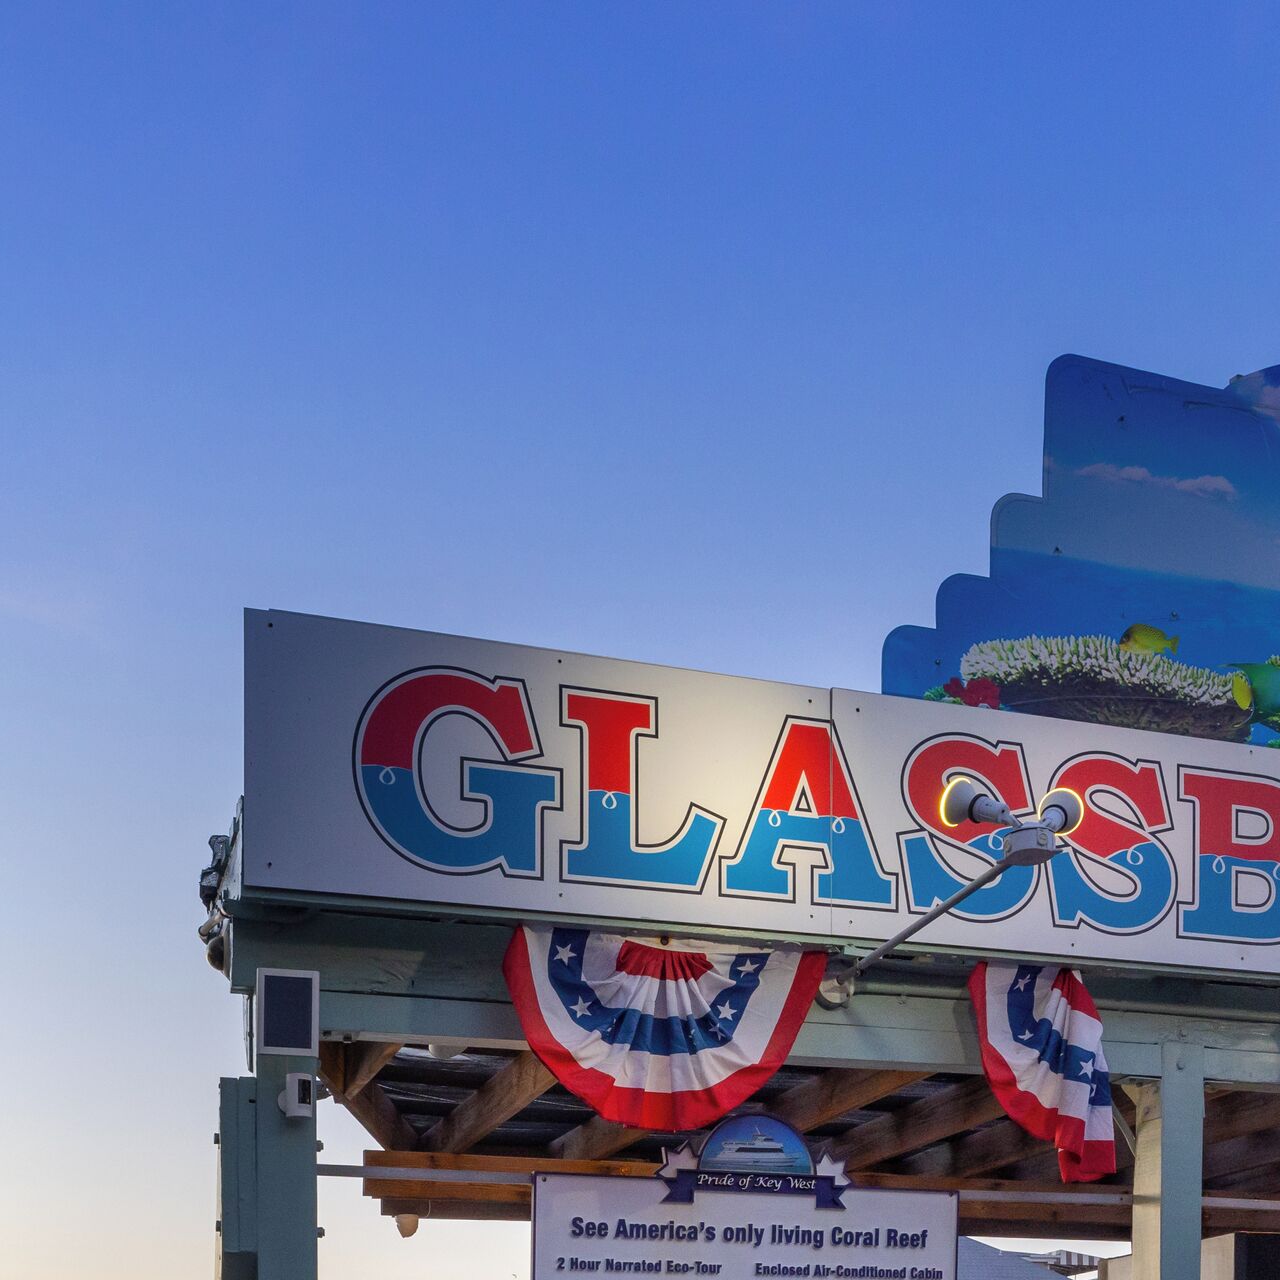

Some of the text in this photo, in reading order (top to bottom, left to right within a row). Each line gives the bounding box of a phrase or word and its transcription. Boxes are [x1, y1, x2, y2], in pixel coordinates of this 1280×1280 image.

[697, 1173, 816, 1192] Pride of Key West
[571, 1217, 928, 1248] See America's only living Coral Reef
[557, 1257, 722, 1274] 2 Hour Narrated Eco-Tour
[755, 1263, 943, 1280] Enclosed Air-Conditioned Cabin
